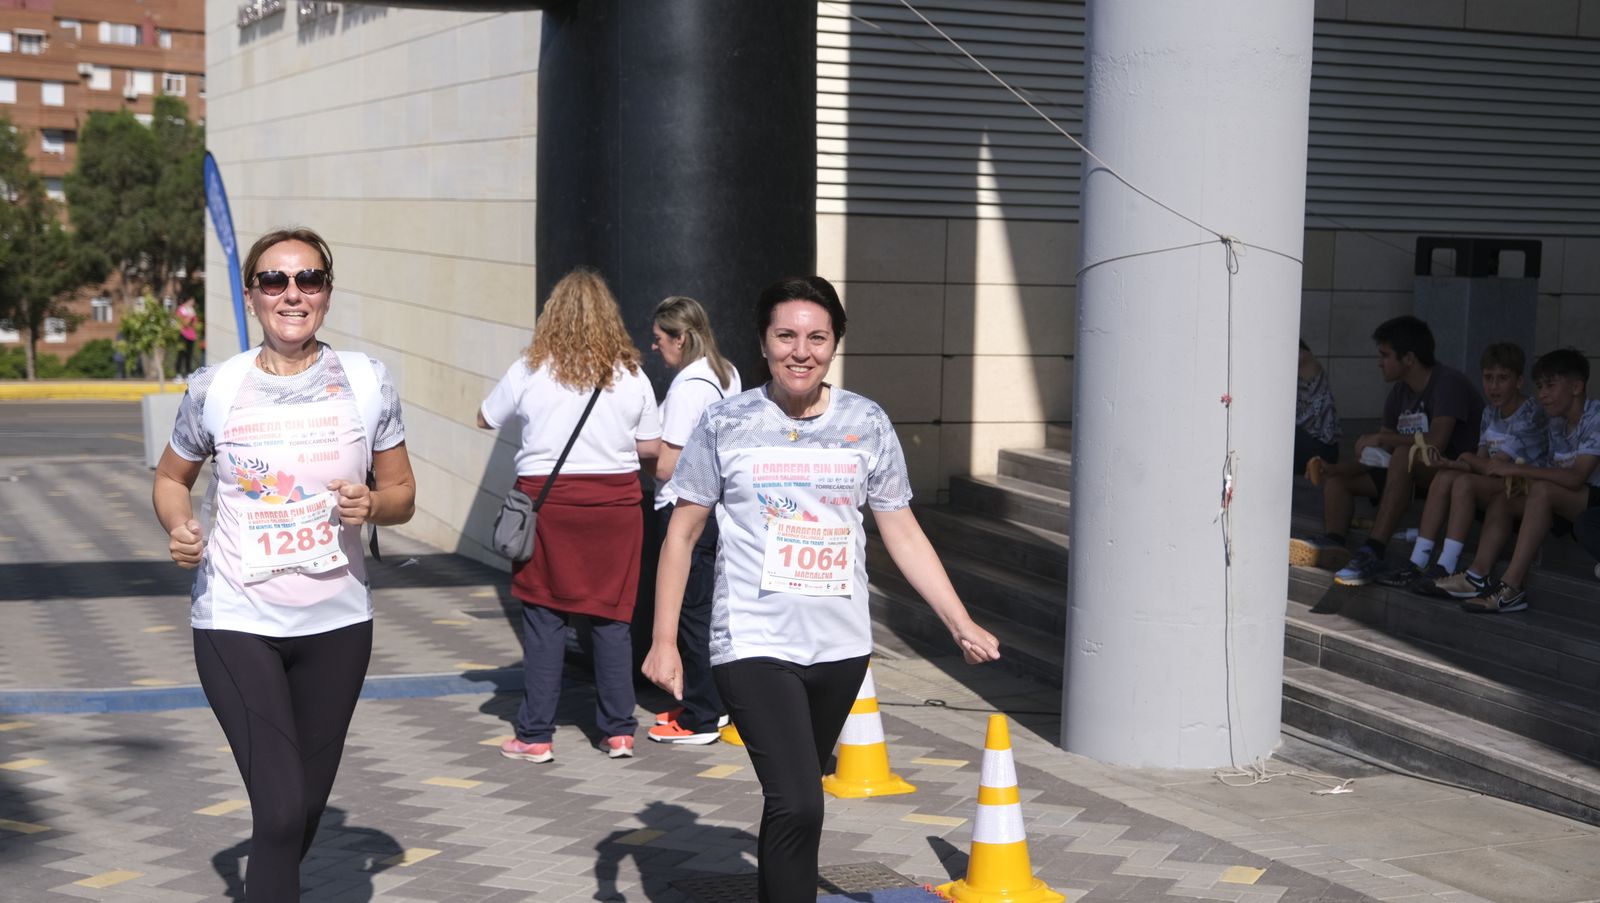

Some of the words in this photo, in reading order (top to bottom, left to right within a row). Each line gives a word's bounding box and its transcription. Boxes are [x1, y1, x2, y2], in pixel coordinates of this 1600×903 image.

[231, 421, 282, 437] CARRERA
[284, 420, 304, 430] SIN
[307, 415, 340, 428] HUMO
[297, 453, 305, 464] 4
[309, 450, 340, 462] JUNIO
[753, 463, 760, 474] II
[762, 463, 811, 473] CARRERA
[813, 463, 832, 474] SIN
[819, 495, 827, 505] 4
[254, 510, 289, 520] CARRERA
[306, 500, 328, 513] HUMO
[778, 523, 784, 532] II
[785, 525, 821, 536] CARRERA
[822, 528, 834, 537] SIN
[257, 521, 334, 556] 1283
[778, 544, 848, 571] 1064
[794, 570, 833, 579] MAGDALENA
